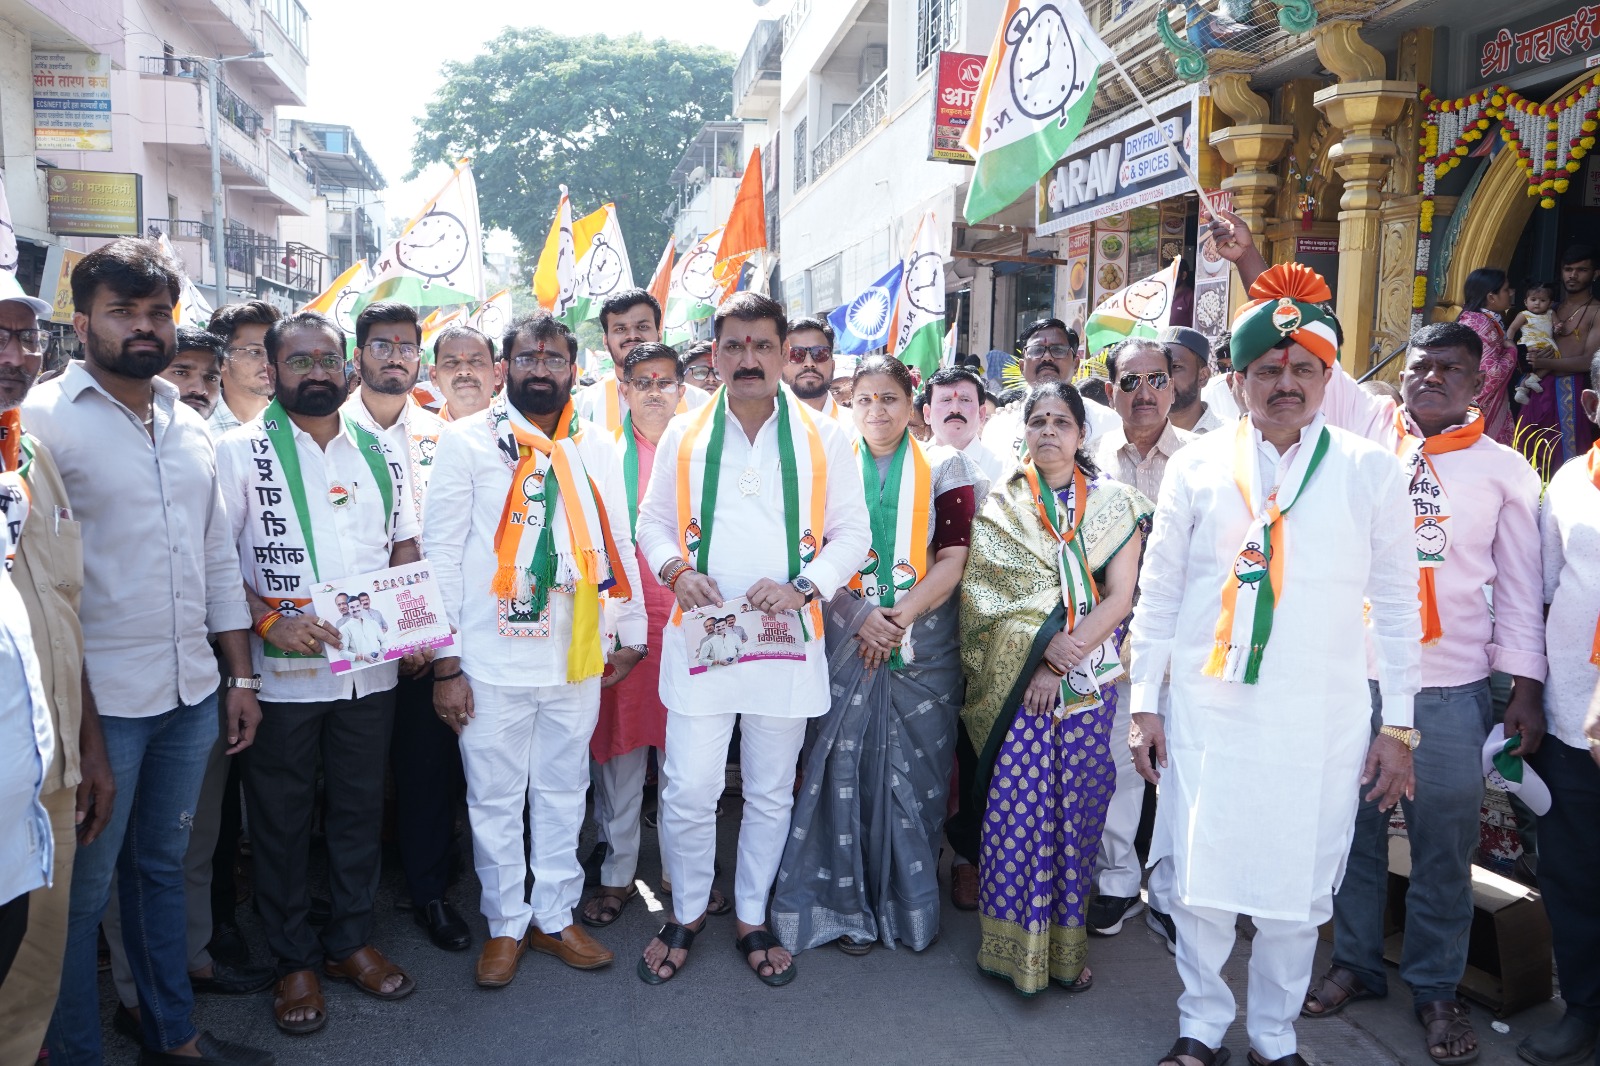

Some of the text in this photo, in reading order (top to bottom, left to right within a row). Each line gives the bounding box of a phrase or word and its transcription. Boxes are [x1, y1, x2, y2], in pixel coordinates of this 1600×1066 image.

[1480, 4, 1600, 78] श्री महालक्ष्म
[34, 70, 108, 88] सोने तारण कर्ज
[1130, 154, 1170, 180] & SPICES
[1052, 143, 1122, 213] ARAV
[72, 180, 130, 195] श्री महालक्ष्मी
[852, 585, 888, 598] N.C.P
[402, 605, 428, 620] ताकद
[397, 613, 438, 632] विकासाची!
[764, 628, 788, 636] ताकद
